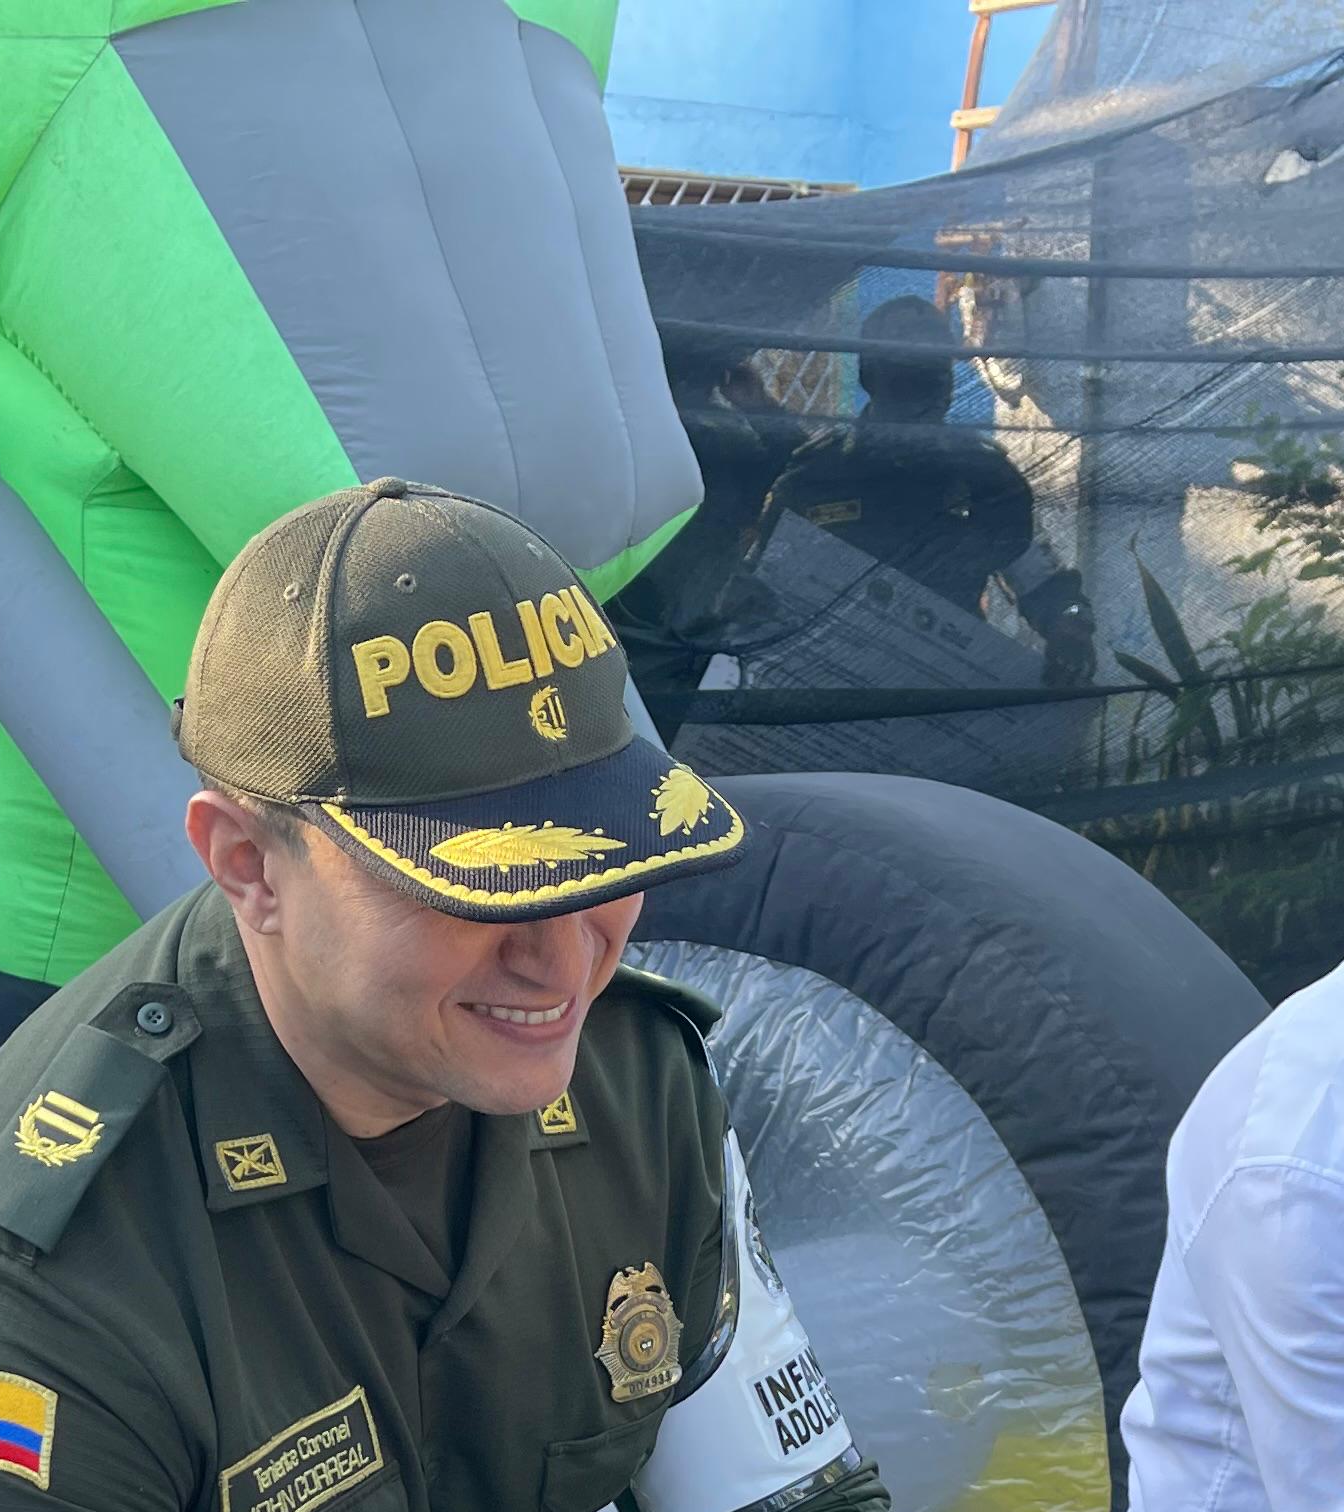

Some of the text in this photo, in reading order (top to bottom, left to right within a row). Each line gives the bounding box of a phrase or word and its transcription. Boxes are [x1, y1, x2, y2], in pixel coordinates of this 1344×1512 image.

[352, 584, 617, 719] POLICIA
[253, 1415, 352, 1493] Teniente Coronel
[294, 1443, 370, 1502] CORREAL
